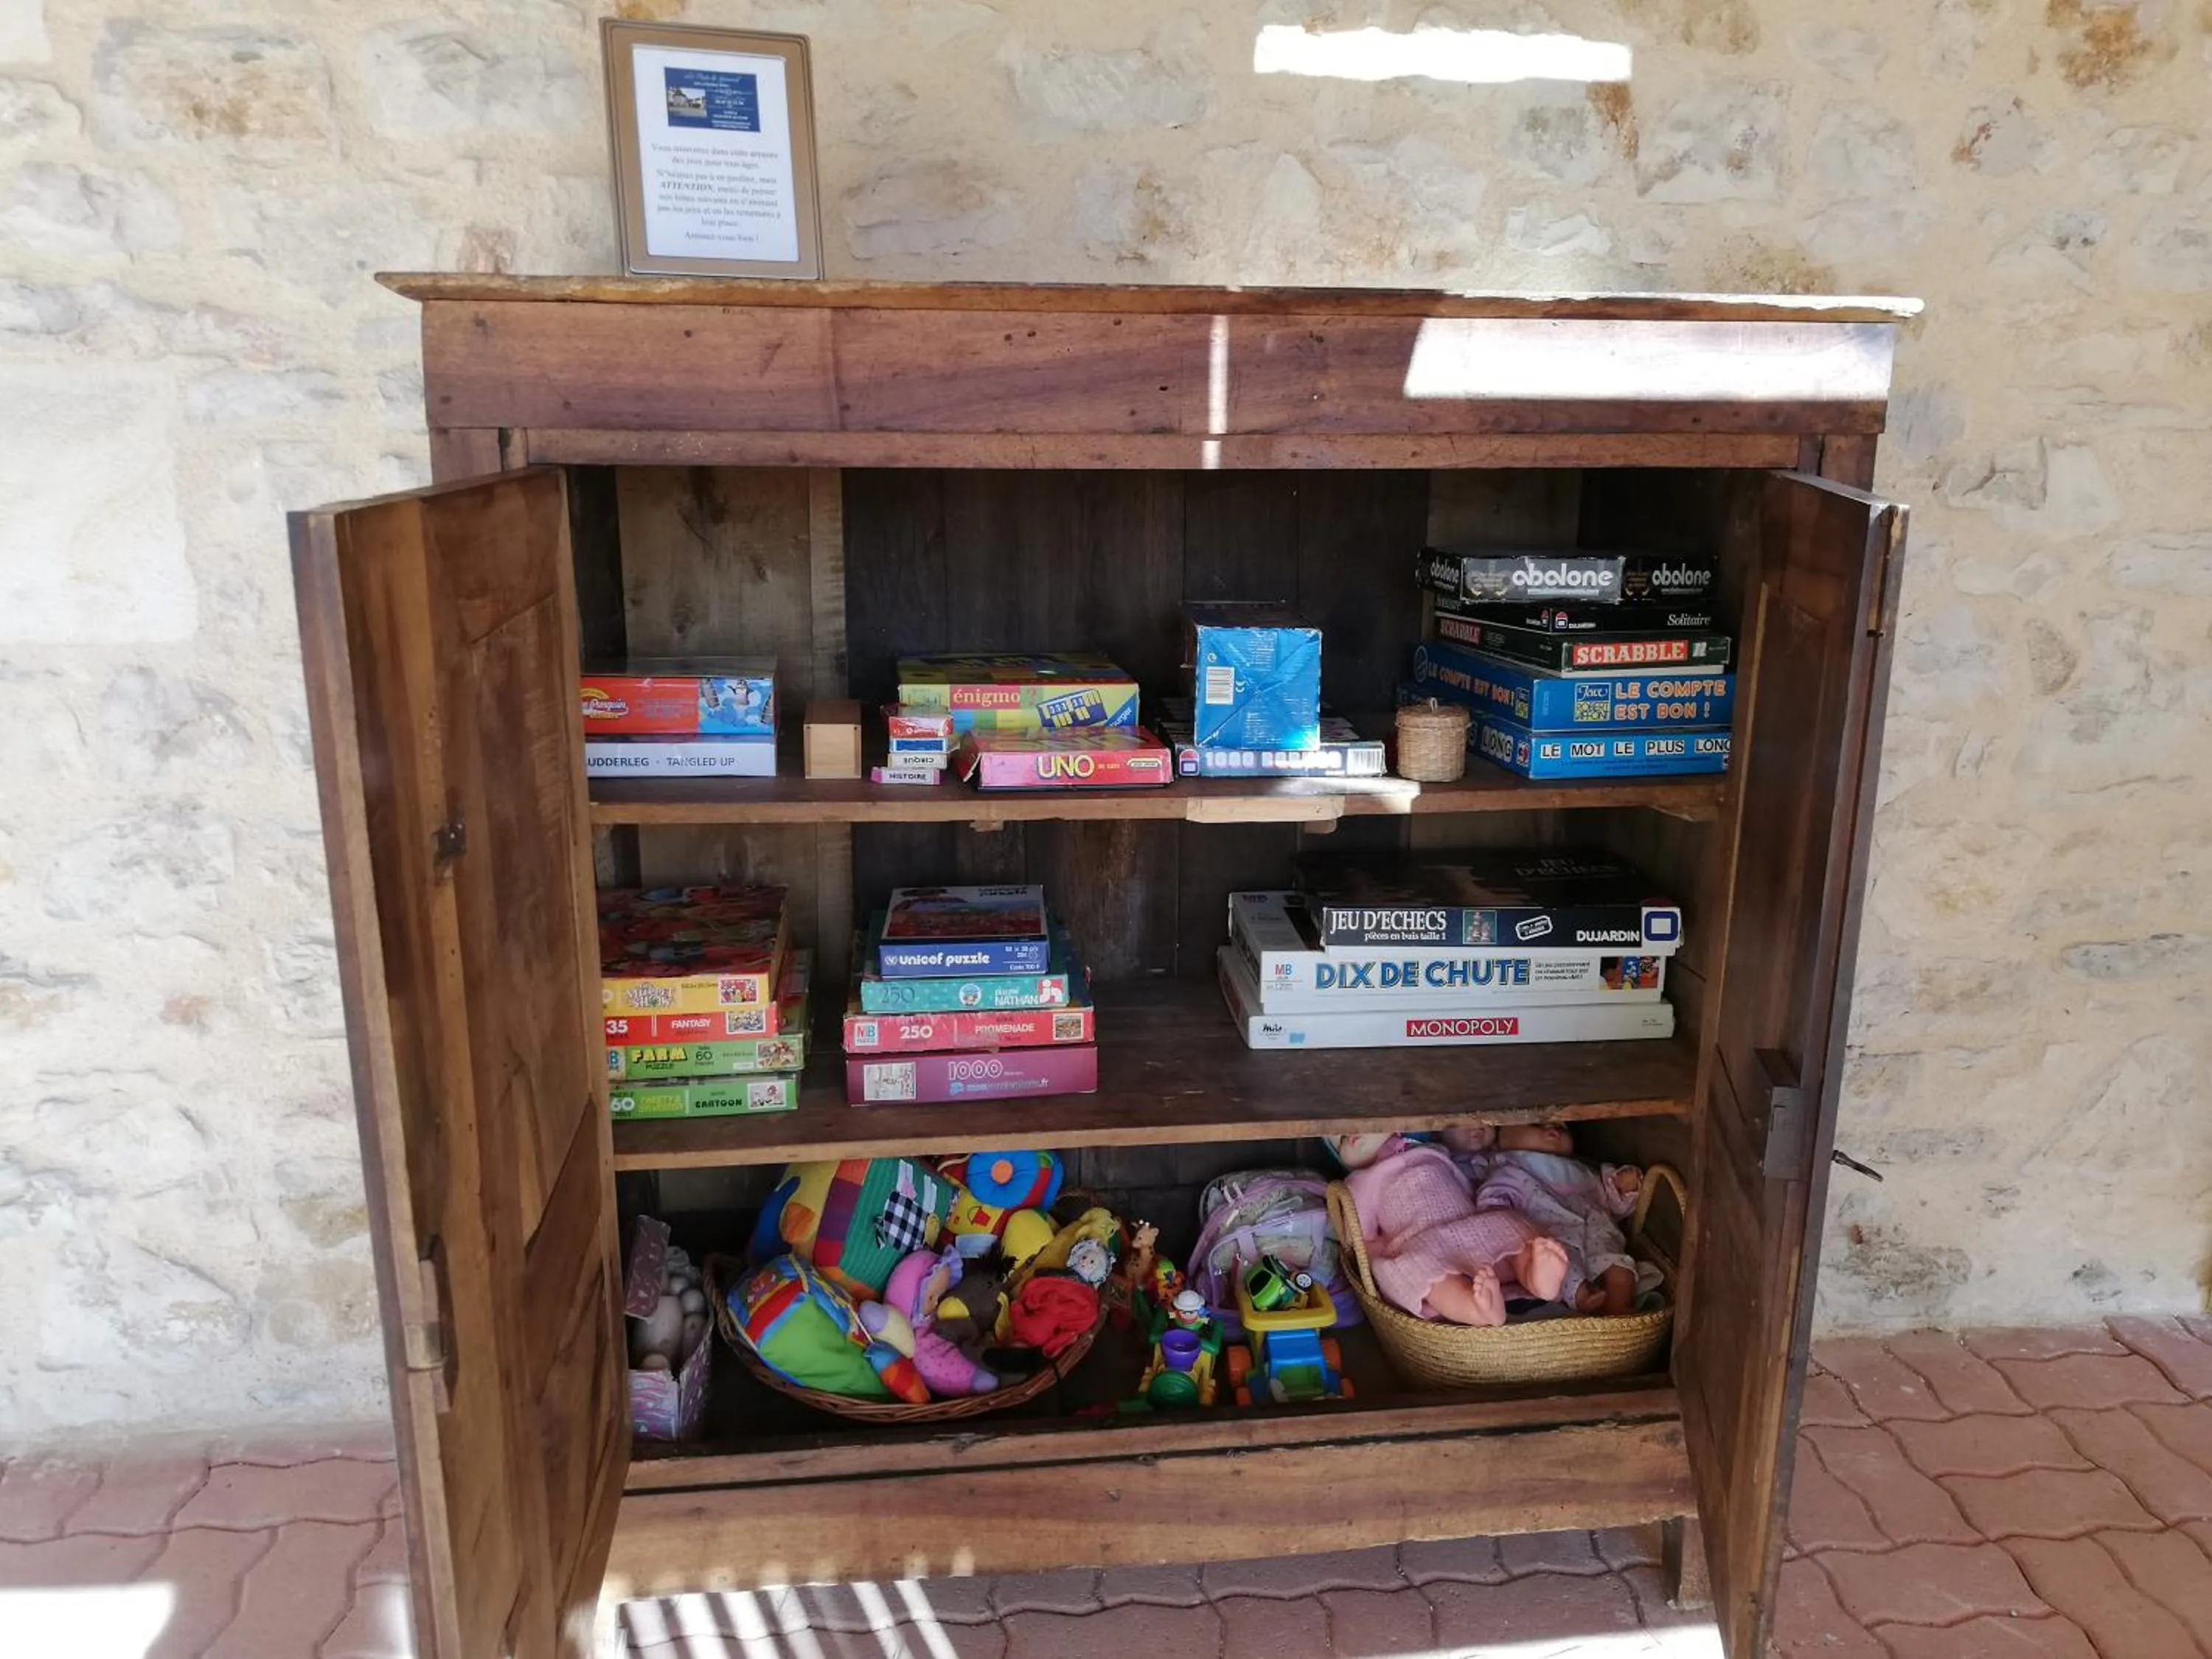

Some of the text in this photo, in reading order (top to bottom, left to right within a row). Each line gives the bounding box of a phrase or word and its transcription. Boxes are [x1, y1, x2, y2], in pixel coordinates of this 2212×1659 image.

[1512, 563, 1613, 587] abalone
[1667, 613, 1711, 626] Solitaire
[1577, 642, 1685, 664] SCRABBLE
[1615, 680, 1727, 699] LE COMPTE
[1614, 703, 1649, 720] EST
[1656, 703, 1697, 720] BON
[1542, 745, 1559, 757] LE
[1571, 743, 1603, 757] MOT
[1615, 742, 1632, 754] LE
[1646, 740, 1683, 754] PLUS
[666, 757, 716, 767] TANGLED
[720, 757, 735, 767] UP
[1037, 754, 1095, 779] UNO
[1329, 911, 1447, 934] JEU D'ECHECS
[1576, 931, 1639, 942] DUJARDIN
[899, 953, 943, 965] unicef
[946, 952, 990, 967] puzzle
[1275, 964, 1292, 975] MB
[1315, 958, 1531, 989] DIX DE CHUTE
[995, 995, 1038, 1006] NATHAN
[606, 1020, 628, 1034] 35
[672, 1018, 712, 1029] FANTASY
[975, 1023, 1035, 1034] PROMENADE
[1411, 1019, 1514, 1035] MONOPOLY
[900, 1024, 933, 1039] 250
[631, 1047, 687, 1063] FARM
[695, 1051, 713, 1061] 60
[948, 1060, 1003, 1080] 1000
[611, 1097, 635, 1111] 60
[695, 1099, 742, 1109] CARTOON
